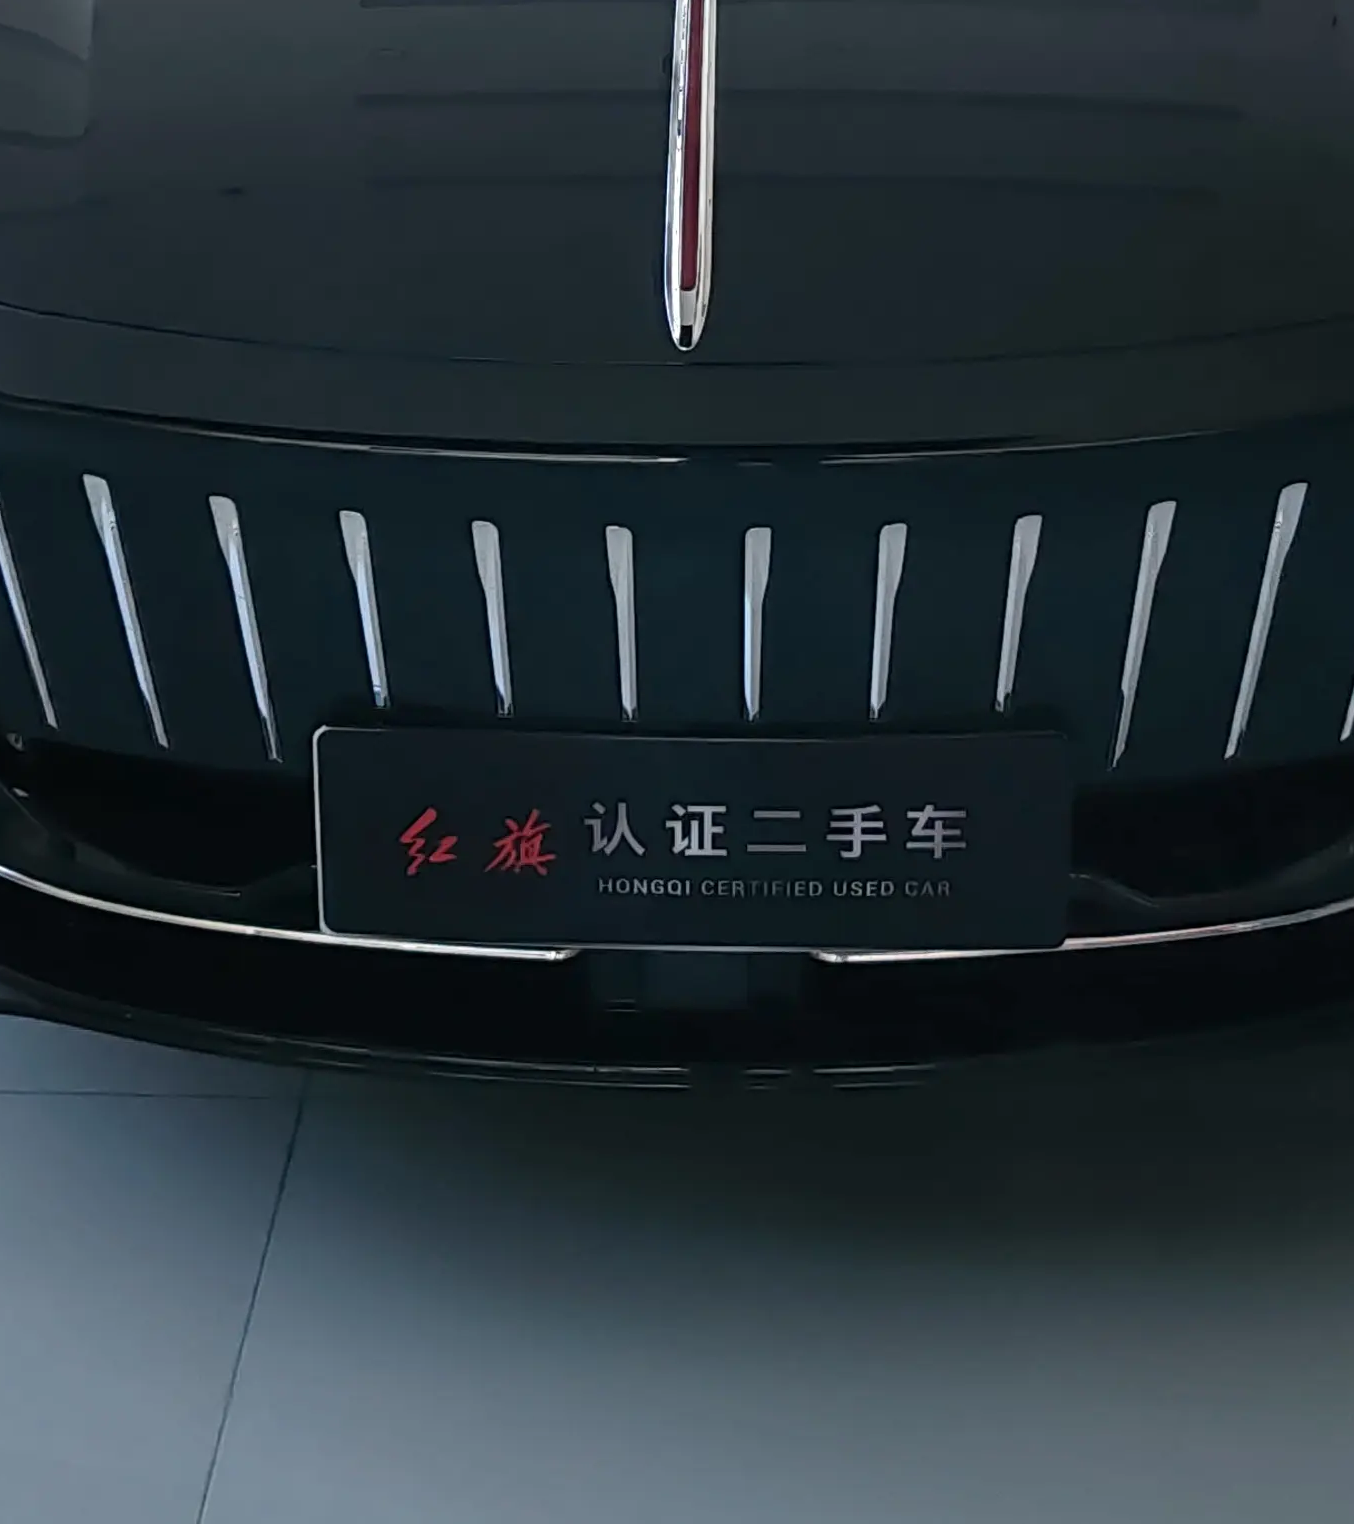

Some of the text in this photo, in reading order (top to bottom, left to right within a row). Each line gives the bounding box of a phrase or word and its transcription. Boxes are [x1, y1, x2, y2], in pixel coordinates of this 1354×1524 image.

[399, 802, 966, 876] 红旗 认证二手车
[599, 878, 950, 898] HONGQI CERTIFIED USED CAR
